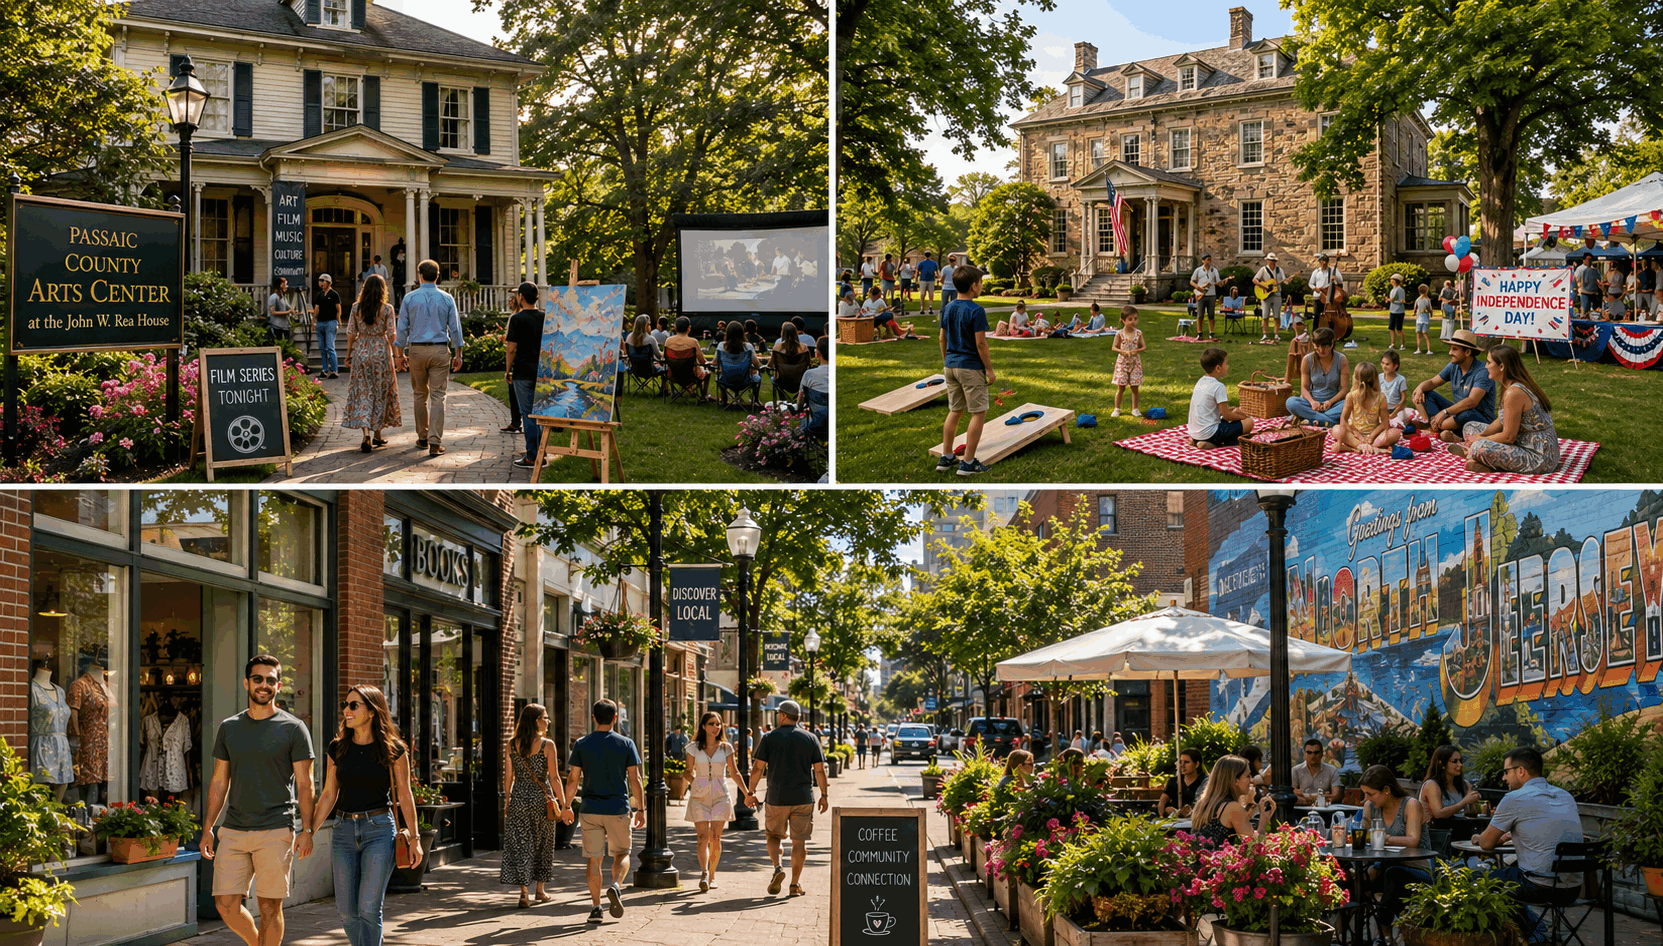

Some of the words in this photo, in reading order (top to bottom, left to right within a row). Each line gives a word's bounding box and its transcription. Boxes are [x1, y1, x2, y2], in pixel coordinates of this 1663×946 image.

[279, 195, 298, 207] ART
[277, 213, 301, 225] FILM
[69, 226, 138, 249] PASSAIC
[275, 231, 303, 243] MUSIC
[65, 253, 142, 274] COUNTY
[27, 278, 83, 303] ARTS
[90, 279, 171, 303] CENTER
[1500, 280, 1541, 293] HAPPY
[1476, 295, 1566, 310] INDEPENDENCE
[27, 318, 41, 329] at
[44, 314, 63, 329] the
[65, 314, 93, 331] John
[96, 314, 111, 327] W.
[114, 314, 135, 327] Rea
[137, 313, 170, 327] House
[1504, 311, 1535, 325] DAY!
[210, 368, 236, 384] FILM
[239, 367, 275, 383] SERIES
[217, 388, 270, 405] TONIGHT
[416, 535, 469, 588] BOOKS
[672, 587, 717, 600] DISCOVER
[677, 605, 712, 620] LOCAL
[858, 828, 898, 841] COFFEE
[848, 850, 909, 863] COMMUNITY
[847, 872, 911, 885] CONNECTION
